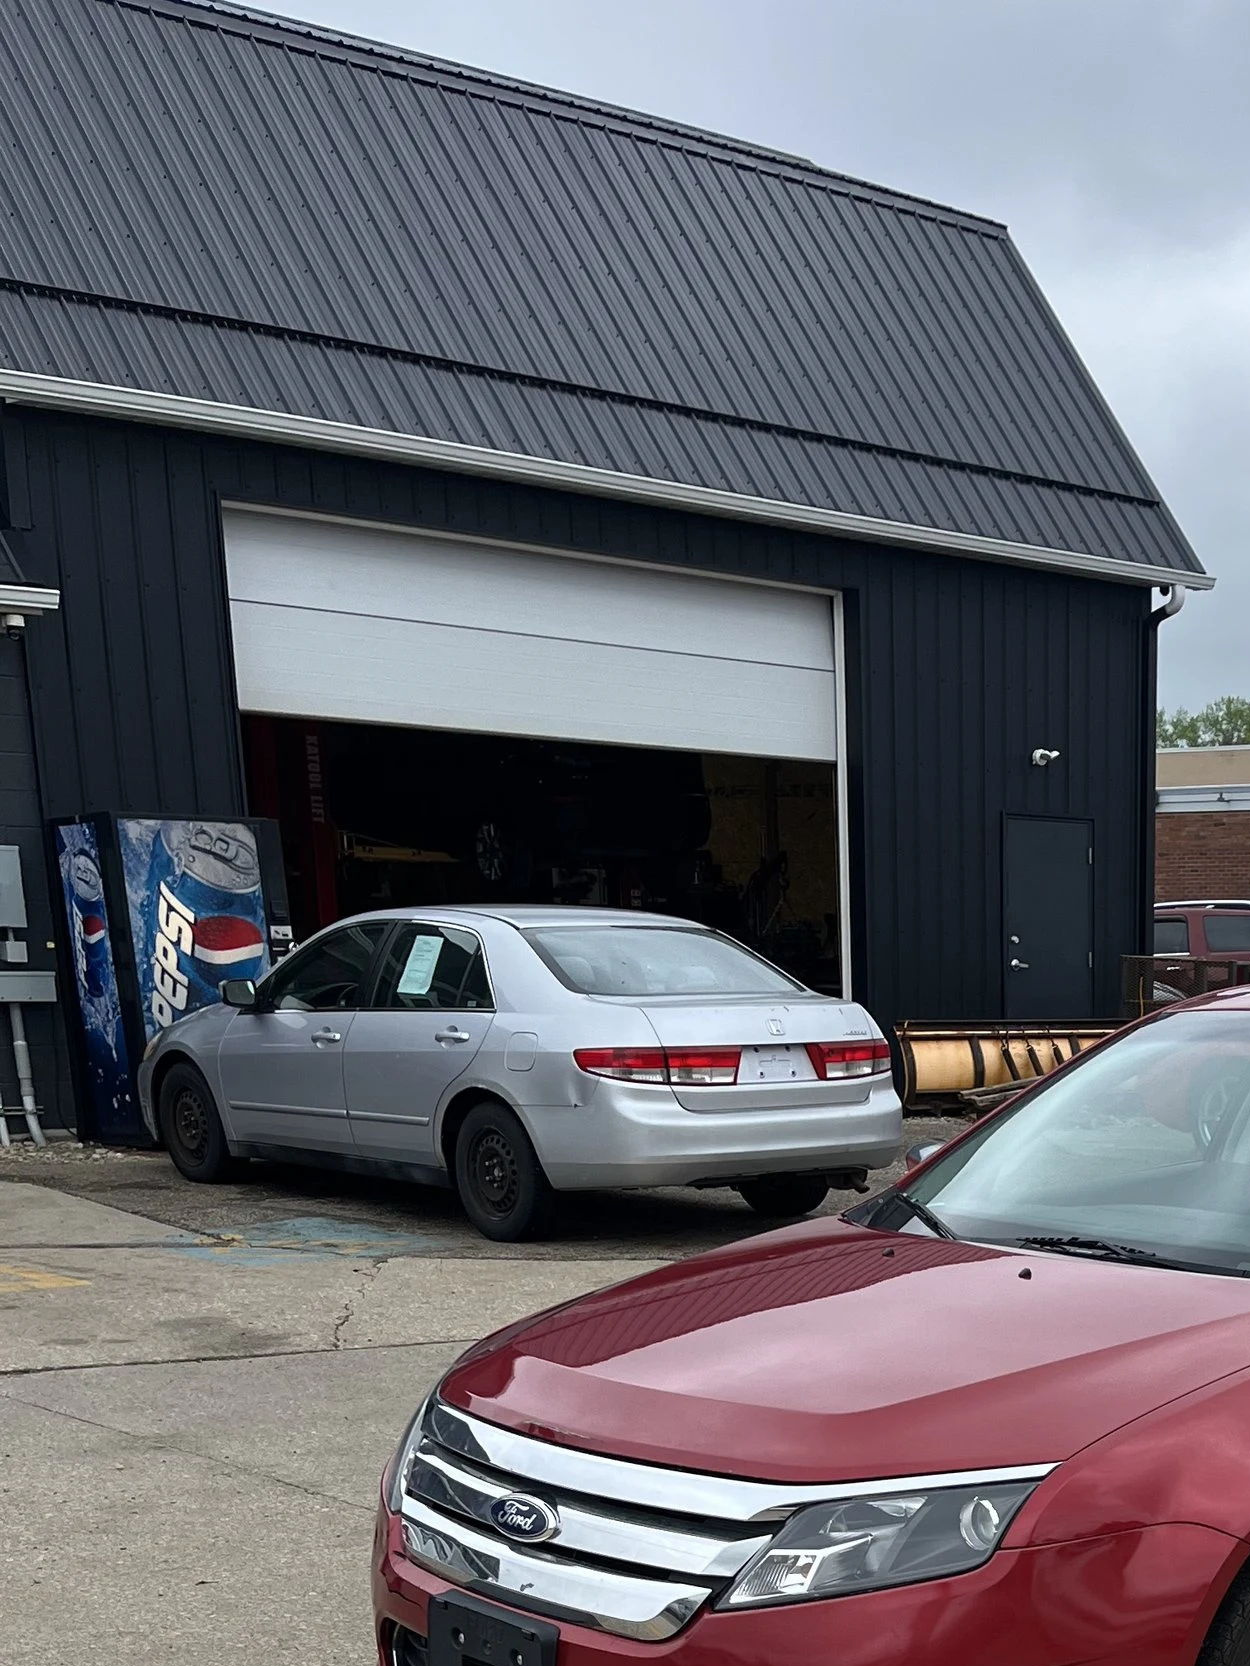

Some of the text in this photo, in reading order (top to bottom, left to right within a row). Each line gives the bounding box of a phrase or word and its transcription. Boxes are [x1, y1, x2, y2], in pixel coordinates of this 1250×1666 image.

[310, 795, 325, 824] LIFT
[152, 880, 195, 1028] PEPSI
[498, 1500, 537, 1531] Ford
